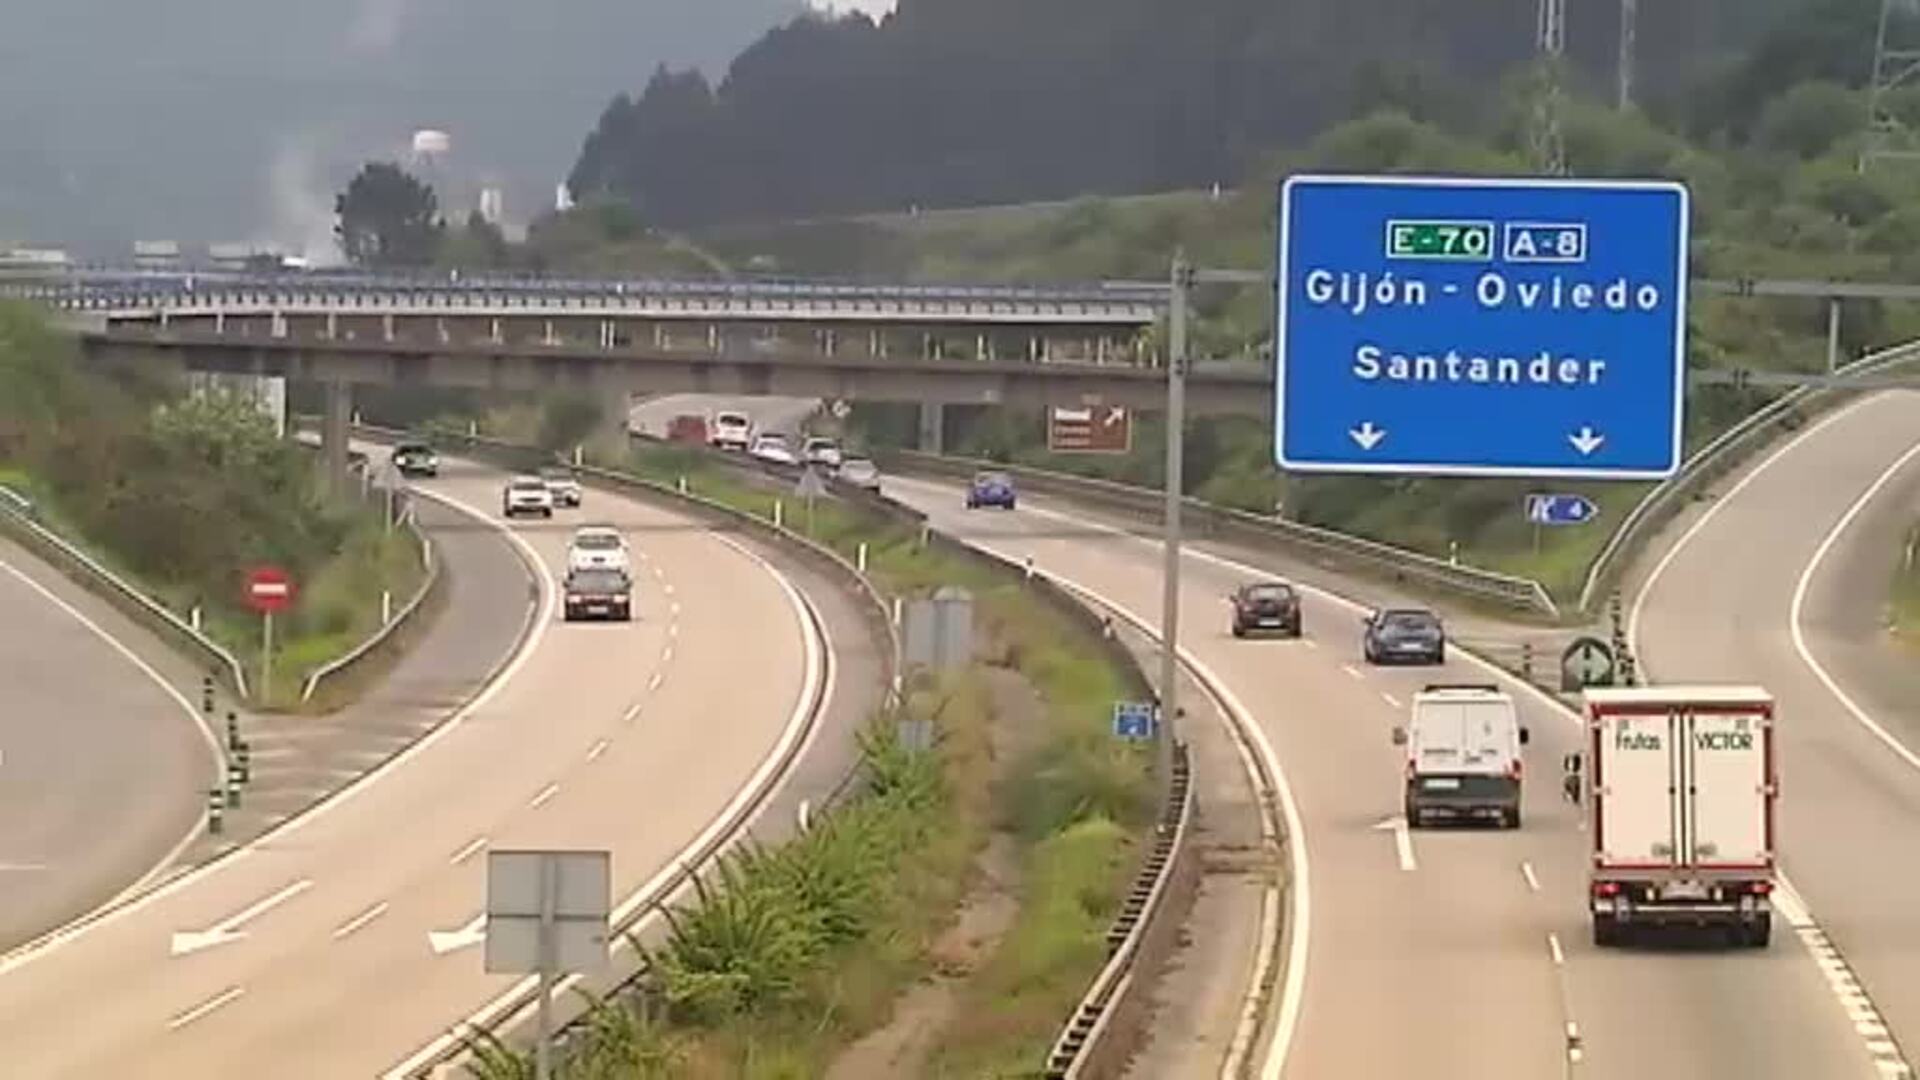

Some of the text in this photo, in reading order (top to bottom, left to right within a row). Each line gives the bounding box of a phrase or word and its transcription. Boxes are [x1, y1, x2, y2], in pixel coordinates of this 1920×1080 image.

[1394, 227, 1579, 256] E-70 A-8
[1305, 269, 1426, 314] Gijón
[1476, 273, 1659, 310] Oviedo
[1353, 345, 1606, 384] Santander
[1695, 732, 1754, 751] VICTOR
